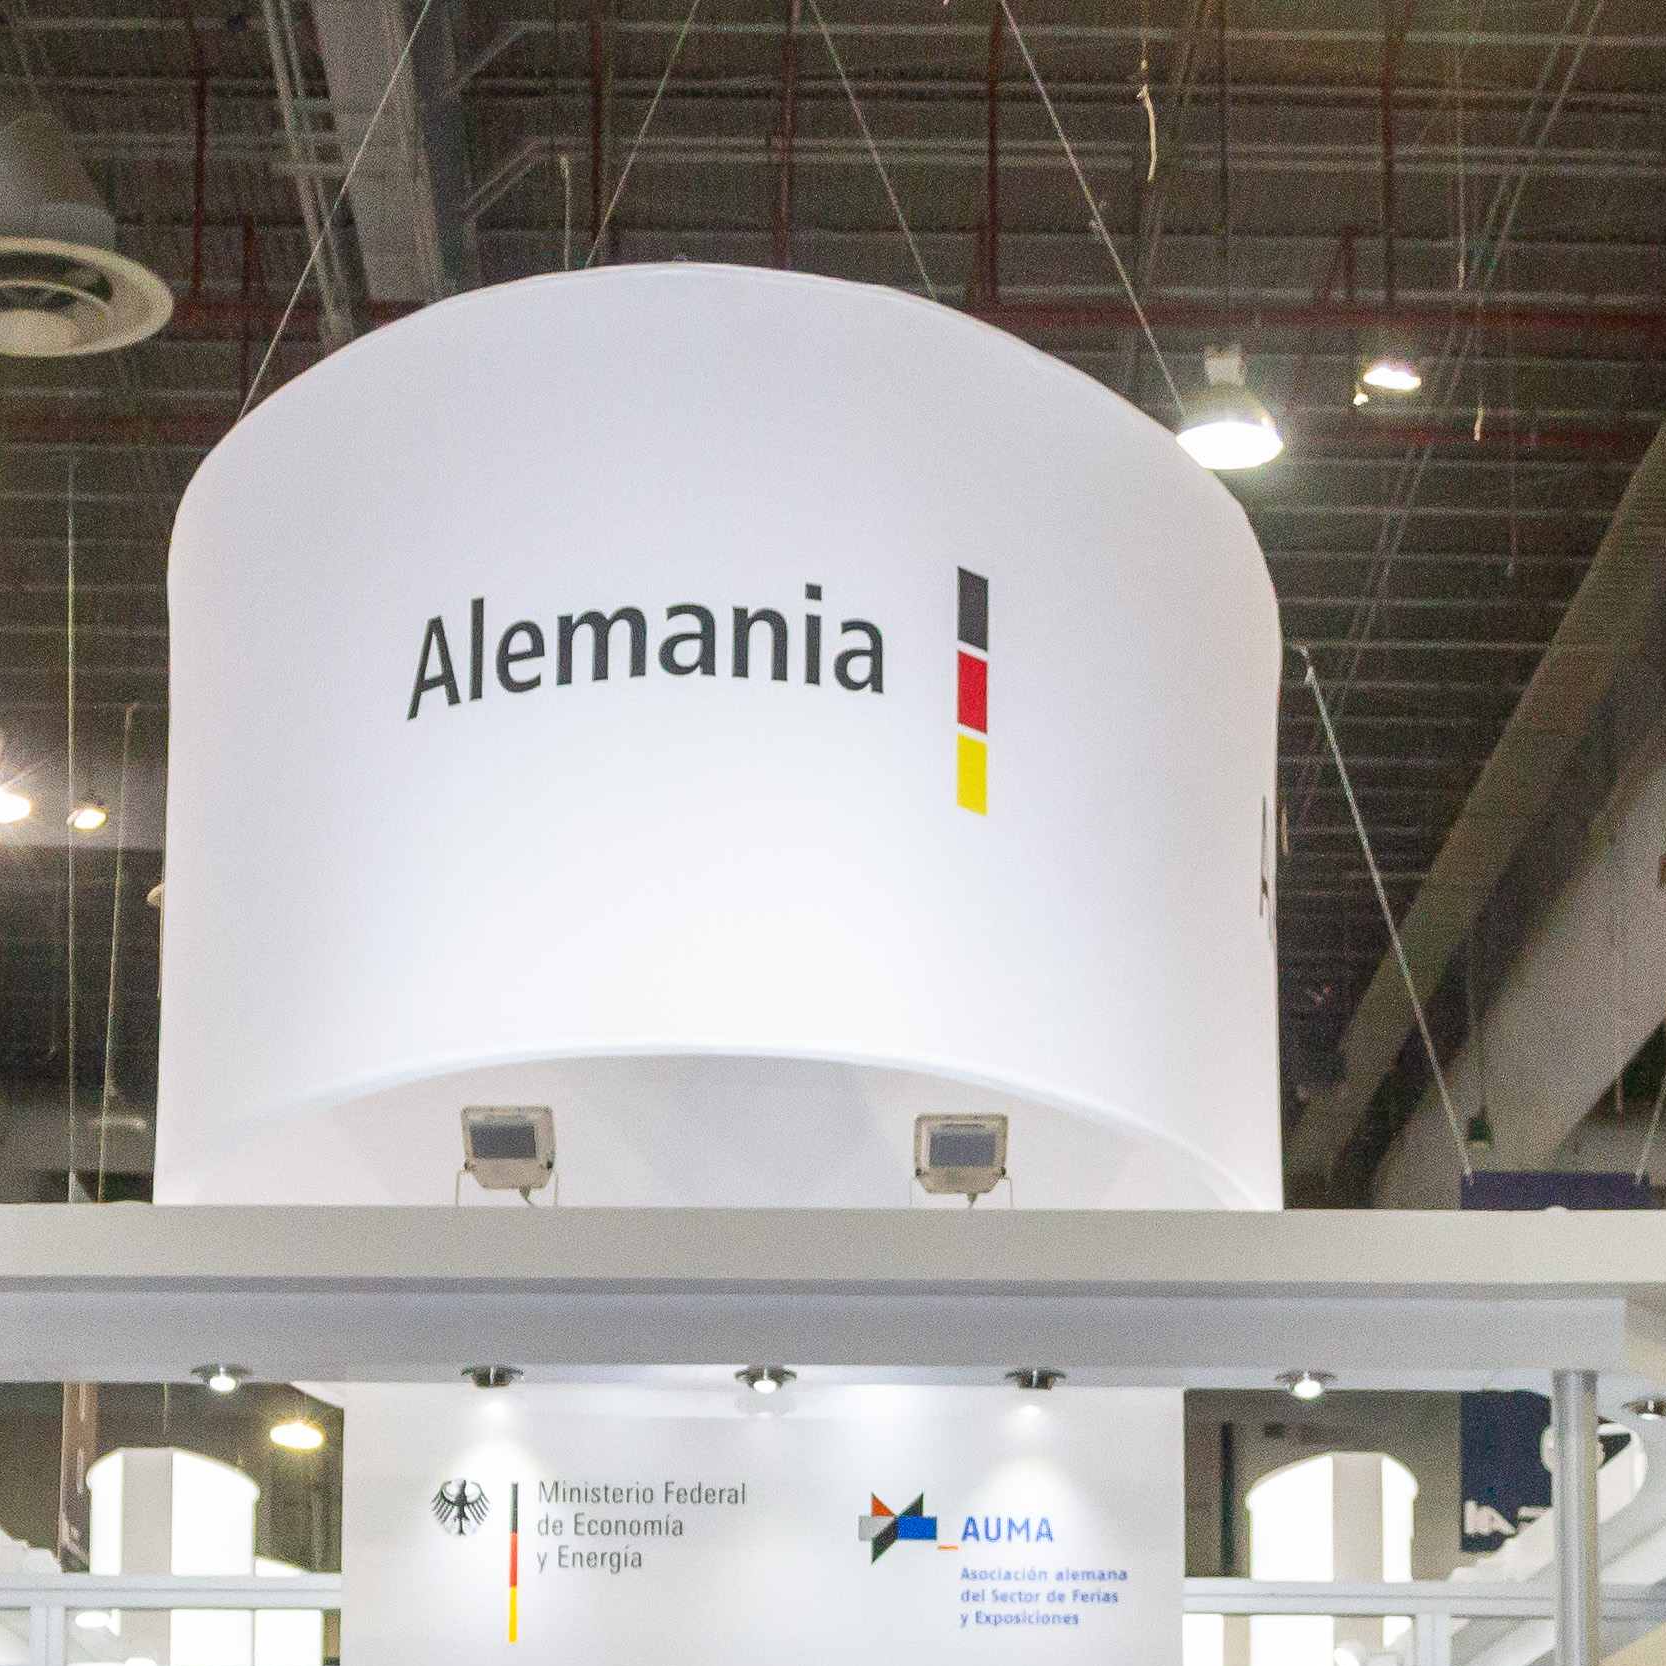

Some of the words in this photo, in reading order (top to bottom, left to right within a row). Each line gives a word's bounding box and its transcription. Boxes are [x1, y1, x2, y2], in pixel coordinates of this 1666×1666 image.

[405, 581, 885, 721] Alemania
[538, 1479, 655, 1505] Ministerio
[664, 1480, 747, 1505] Federal
[537, 1513, 564, 1537] de
[573, 1511, 684, 1538] Economía
[960, 1515, 1055, 1543] AUMA
[536, 1551, 548, 1575] y
[557, 1543, 643, 1575] Energía
[960, 1566, 1048, 1582] Asociación
[1054, 1567, 1129, 1582] alemana
[960, 1588, 985, 1604] del
[991, 1588, 1041, 1604] Sector
[1046, 1589, 1066, 1604] de
[1071, 1588, 1120, 1604] Ferias
[959, 1612, 969, 1628] y
[974, 1609, 1080, 1627] Exposiciones
